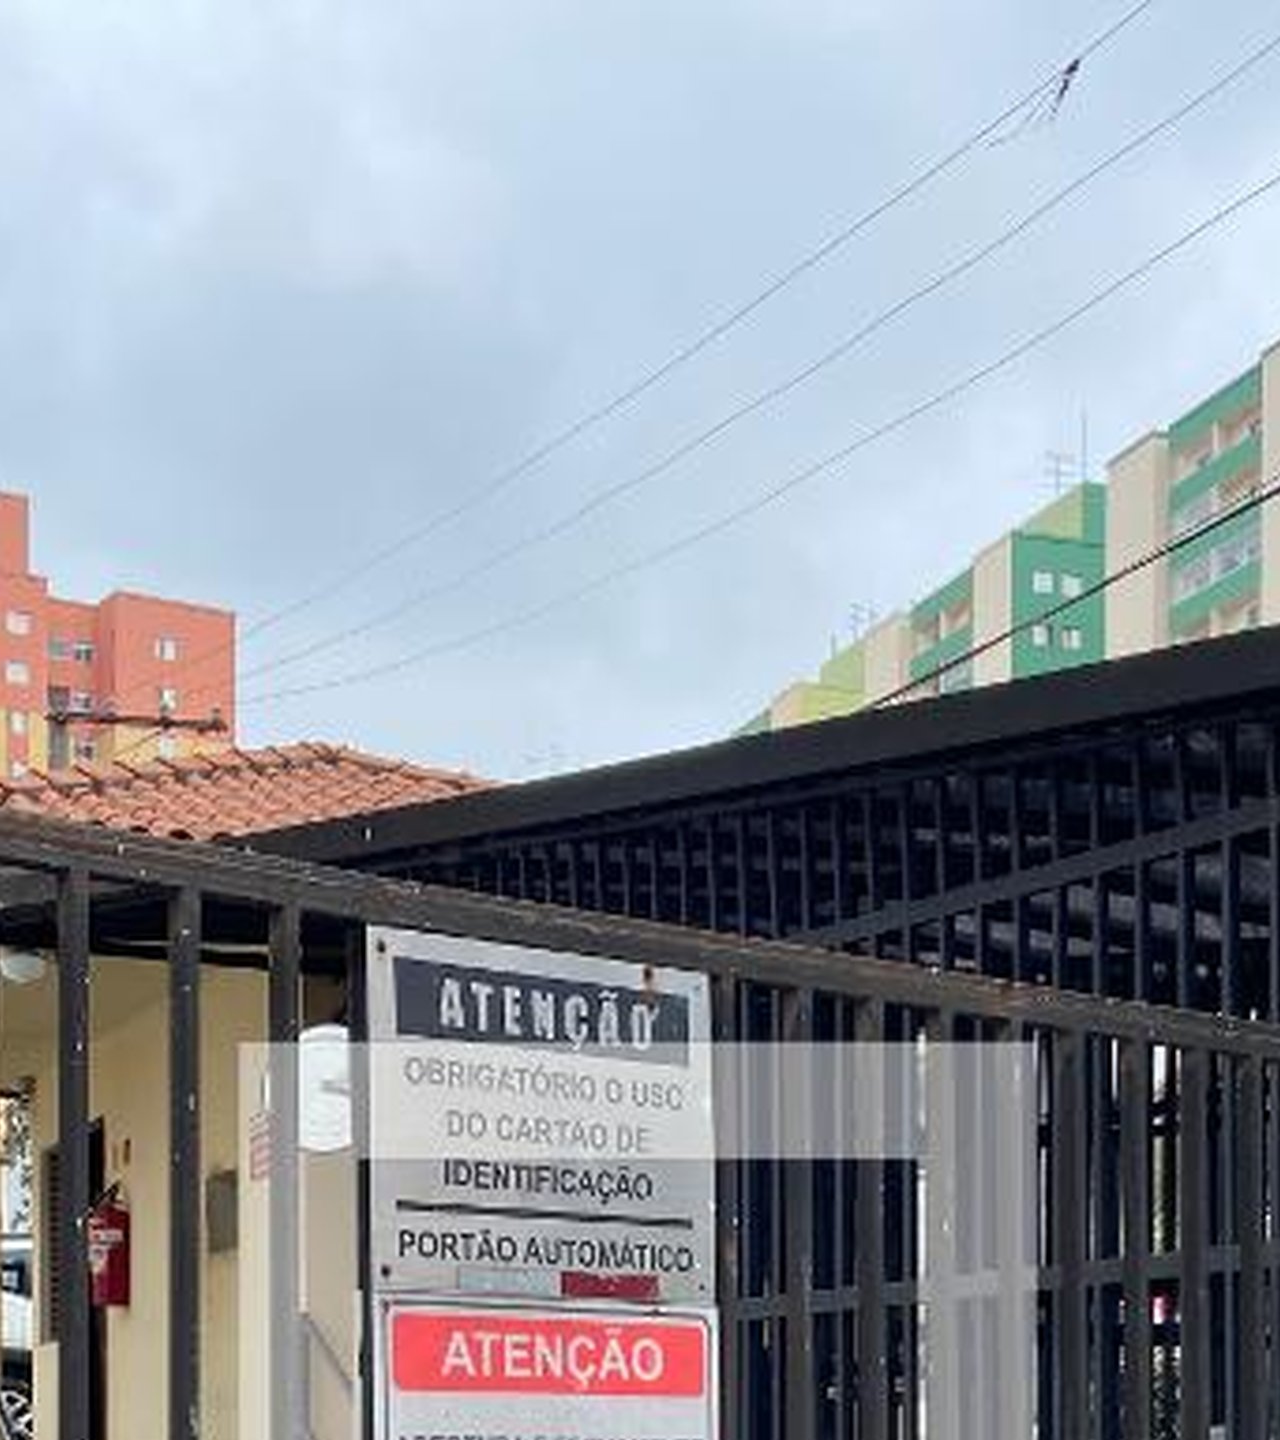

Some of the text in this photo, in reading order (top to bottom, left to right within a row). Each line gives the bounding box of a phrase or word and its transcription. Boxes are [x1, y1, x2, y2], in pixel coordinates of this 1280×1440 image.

[439, 977, 659, 1051] ATENÇÃO
[404, 1056, 597, 1103] OBRIGATÓRIO
[446, 1110, 487, 1139] DO
[618, 1124, 650, 1153] DE
[444, 1159, 653, 1204] IDENTIFICAÇÃO
[398, 1229, 518, 1262] PORTÃO
[441, 1327, 665, 1388] ATENÇÃO
